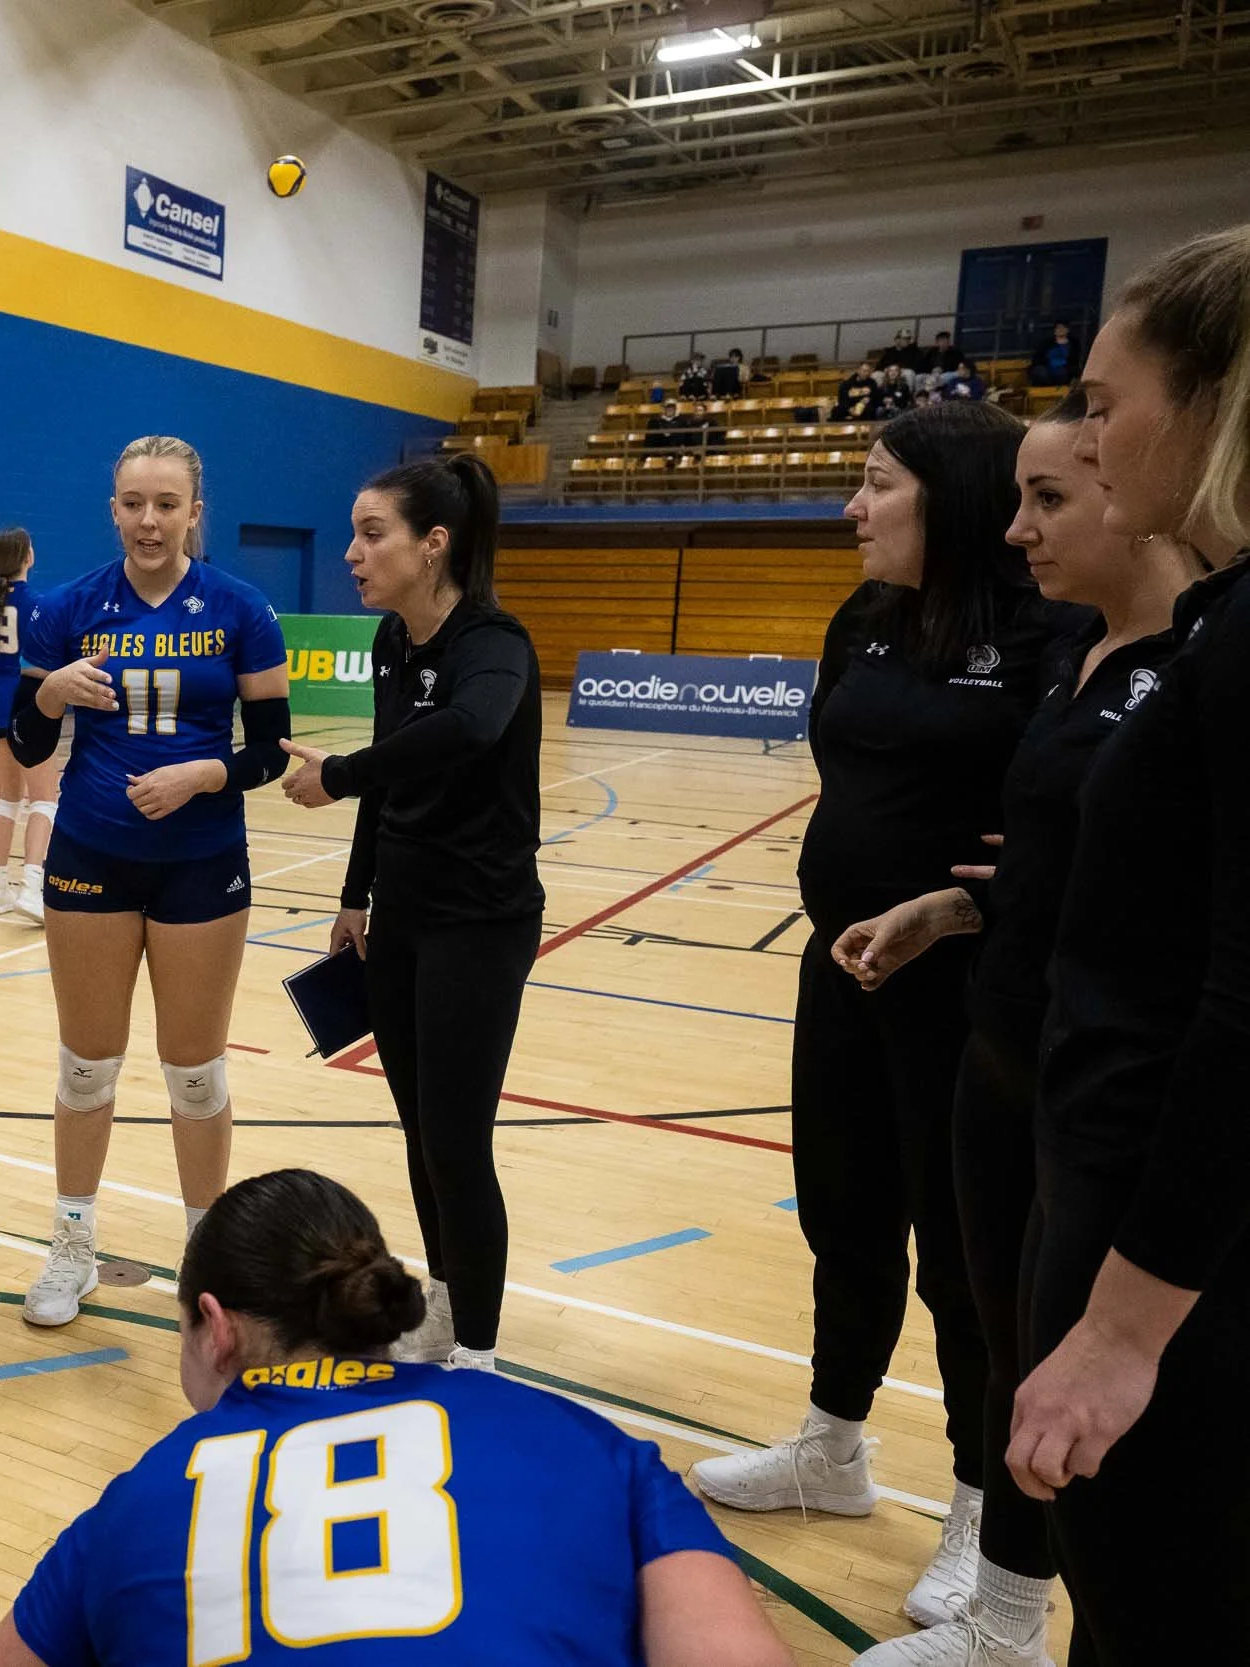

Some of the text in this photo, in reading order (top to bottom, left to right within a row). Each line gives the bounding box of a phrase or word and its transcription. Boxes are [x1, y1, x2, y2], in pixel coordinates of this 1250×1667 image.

[155, 193, 220, 237] Cansel
[154, 628, 226, 657] BLEUES
[286, 649, 373, 683] UBW
[948, 678, 1004, 688] VOLLEYBALL
[121, 668, 181, 736] 11
[589, 698, 628, 707] quotidien
[629, 700, 688, 711] francophone
[689, 704, 701, 712] du
[185, 1399, 463, 1667] 18
